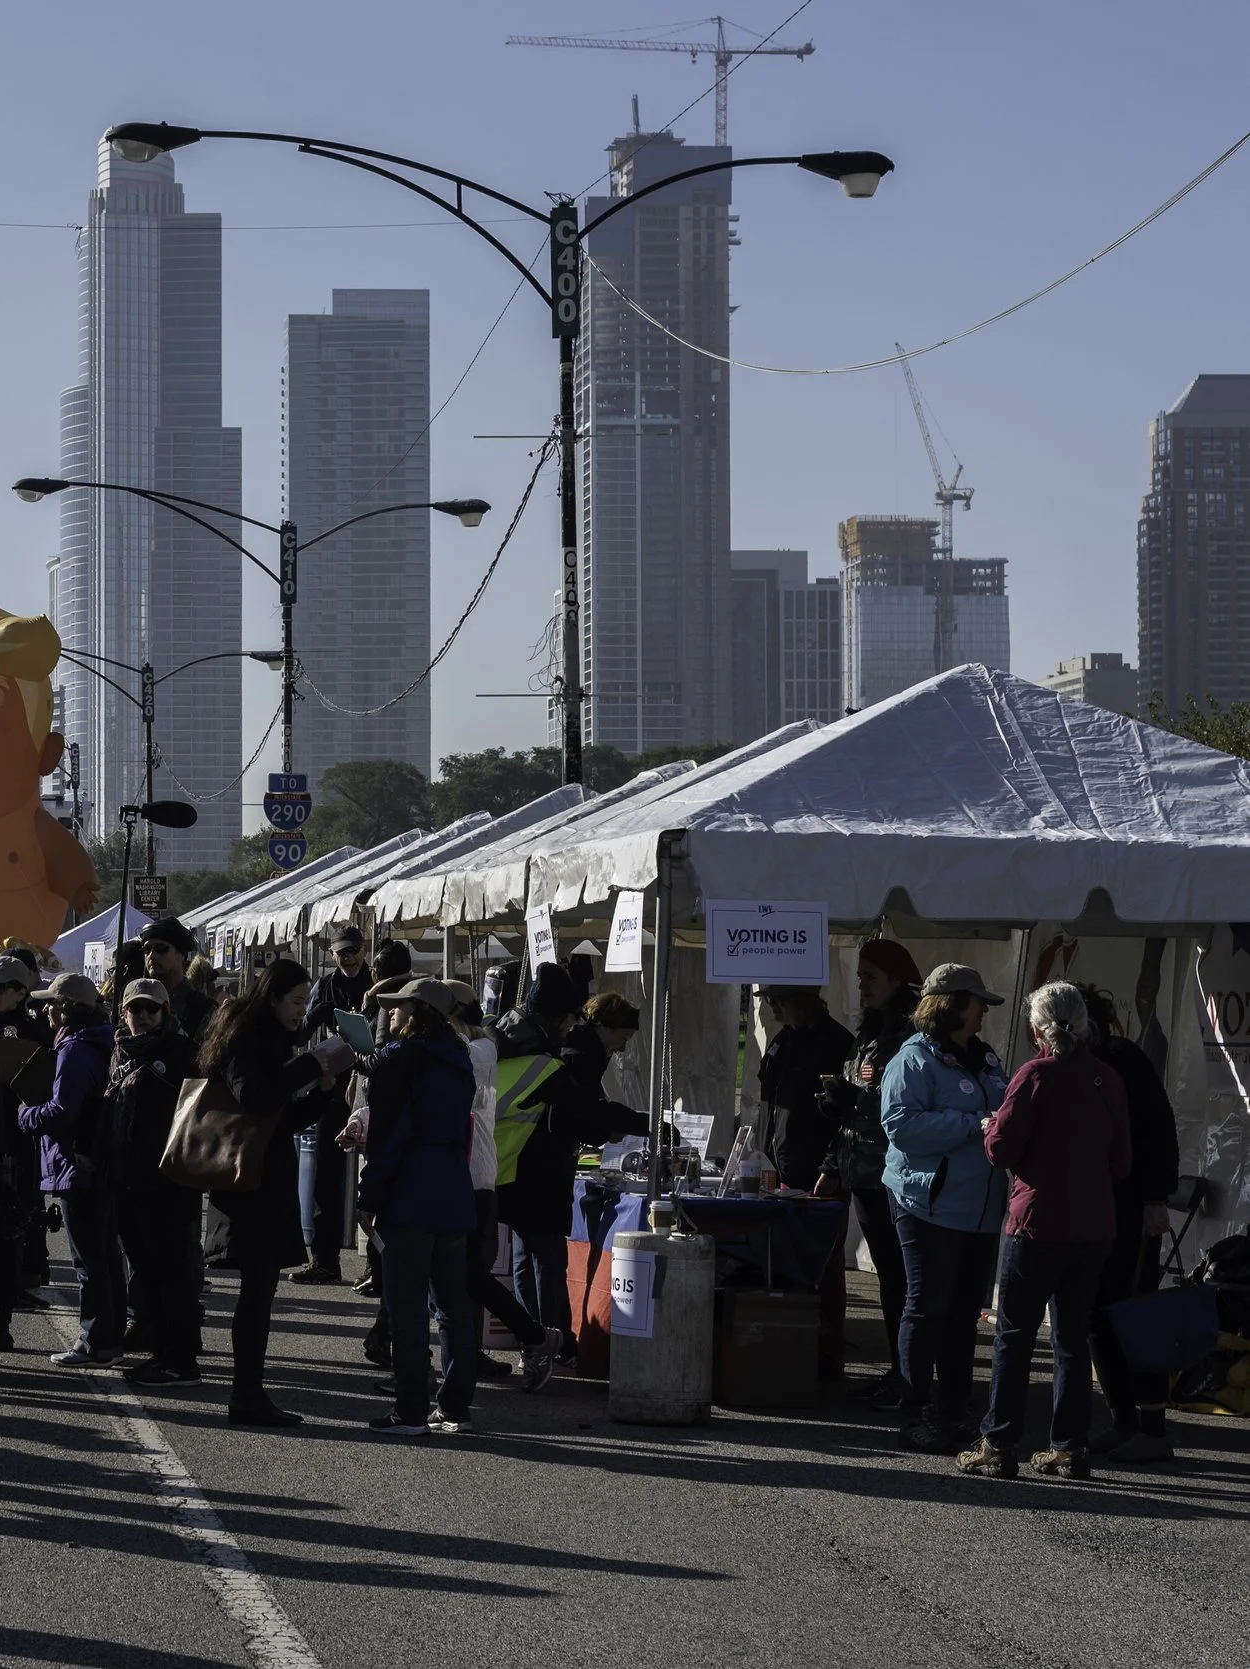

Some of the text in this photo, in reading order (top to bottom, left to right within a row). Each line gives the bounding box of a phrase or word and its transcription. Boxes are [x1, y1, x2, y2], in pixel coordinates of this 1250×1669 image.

[555, 219, 578, 323] C400
[282, 532, 296, 595] C410
[143, 672, 154, 717] C420
[284, 726, 292, 773] C410
[71, 748, 79, 782] C430
[280, 777, 297, 790] TO
[271, 804, 305, 822] 290
[273, 832, 301, 840] INTERSTATE
[274, 844, 301, 863] 90
[727, 928, 807, 944] VOTING IS
[742, 946, 806, 955] people power
[623, 1279, 634, 1293] IS
